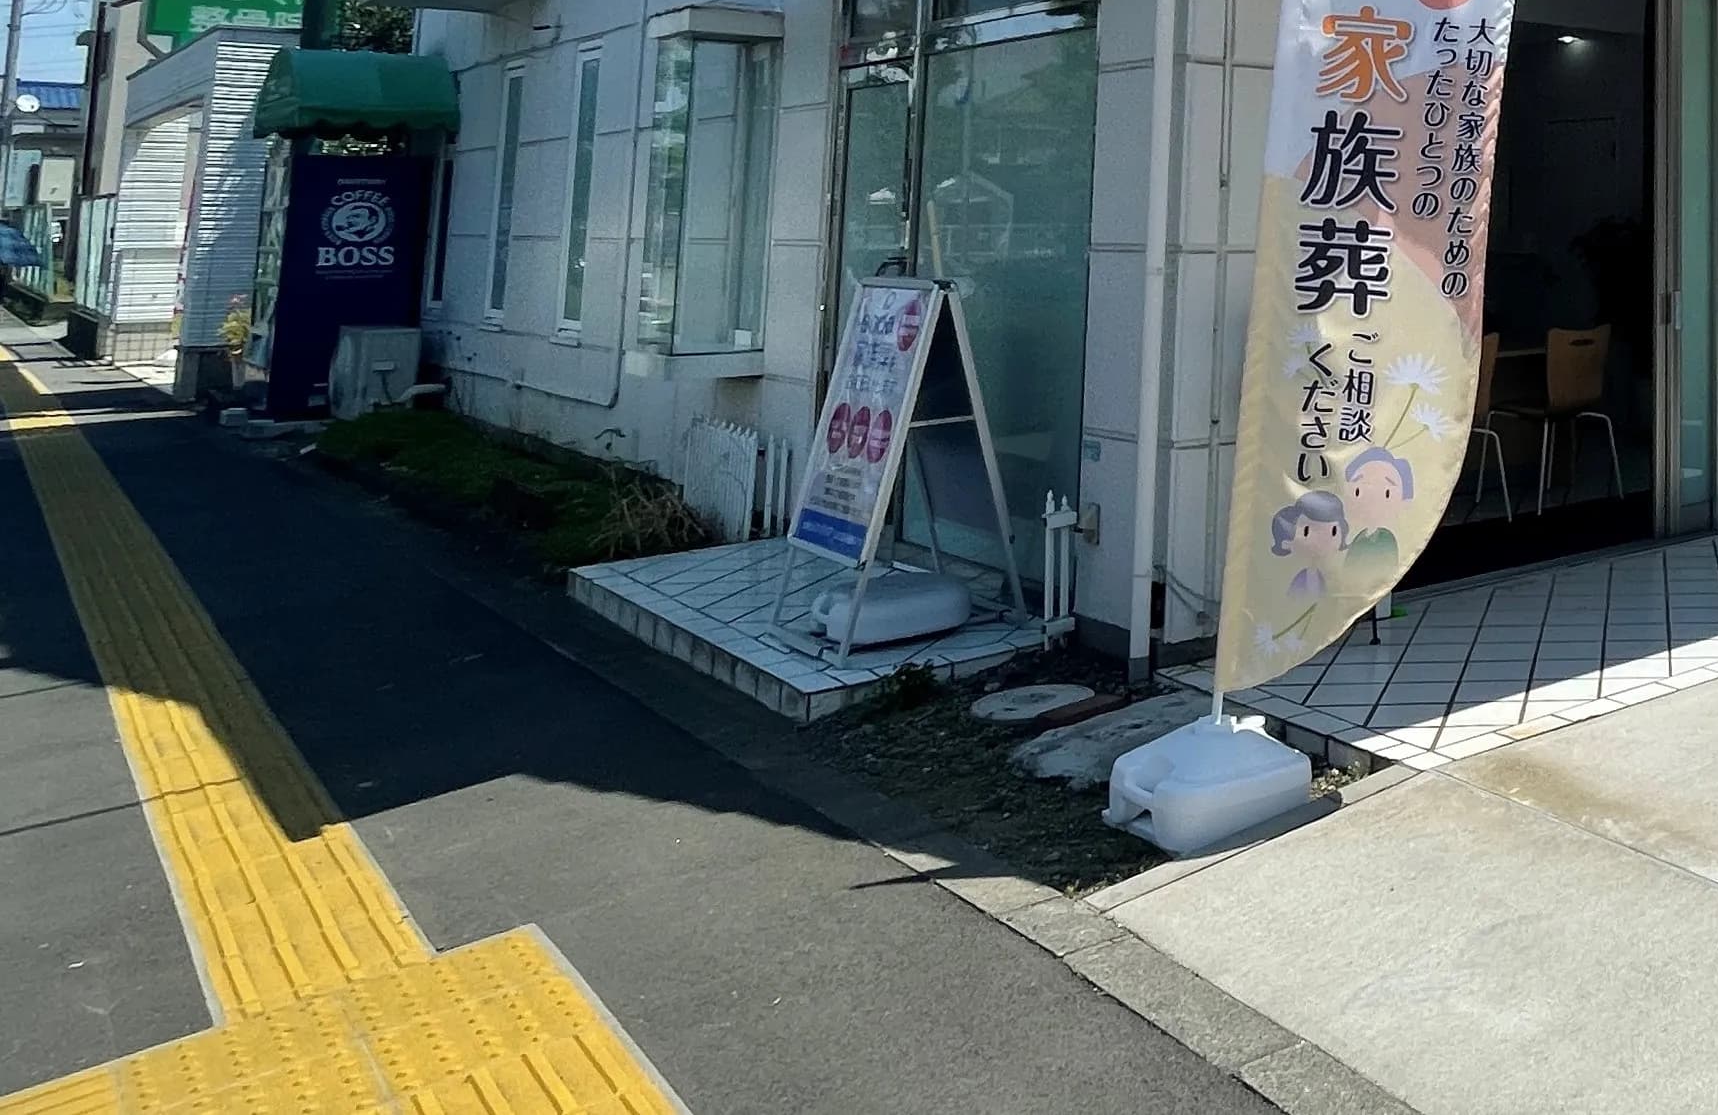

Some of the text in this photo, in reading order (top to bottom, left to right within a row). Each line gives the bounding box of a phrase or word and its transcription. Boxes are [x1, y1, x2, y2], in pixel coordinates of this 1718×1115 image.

[1294, 5, 1414, 317] 家族葬
[1411, 17, 1460, 218] たったひとつの
[1441, 18, 1497, 297] 大切な家族のための
[315, 245, 395, 267] BOSS
[1297, 341, 1339, 482] ください
[1337, 330, 1381, 444] ご相談
